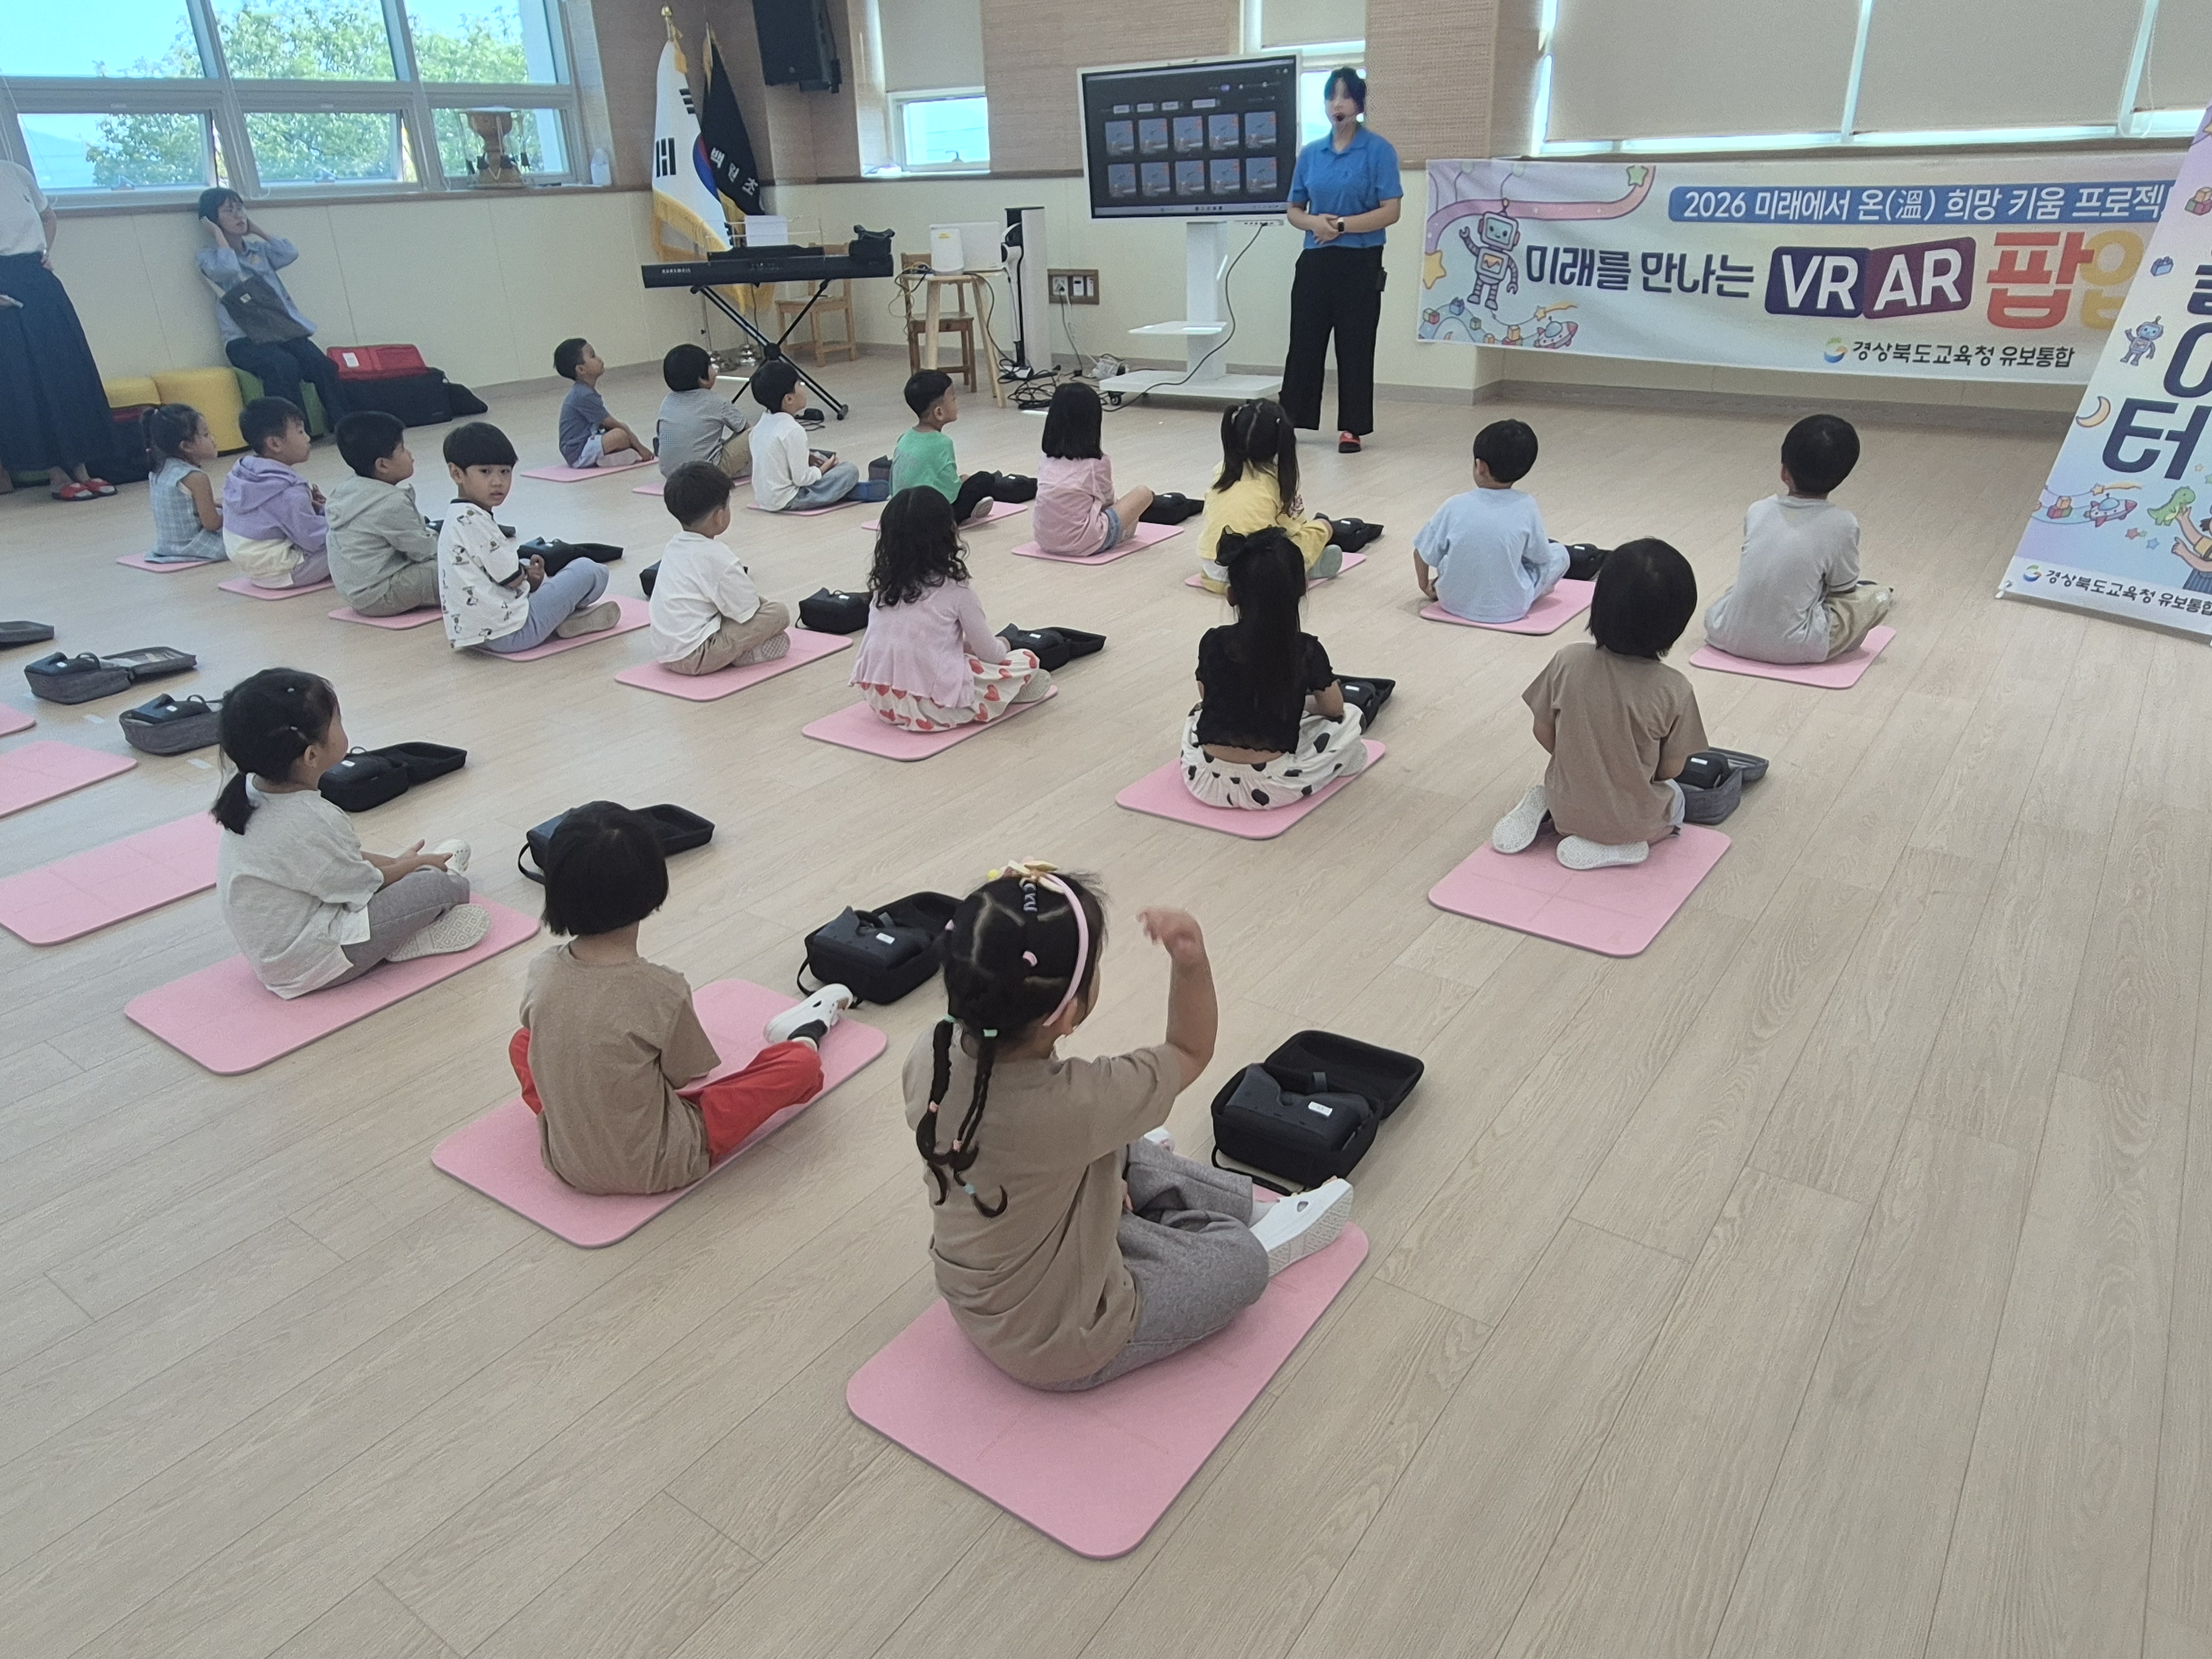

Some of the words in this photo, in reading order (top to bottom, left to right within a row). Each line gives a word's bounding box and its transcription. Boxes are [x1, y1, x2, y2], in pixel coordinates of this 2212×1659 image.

[1683, 191, 1746, 218] 2026
[1755, 189, 1851, 221] 미래에서
[1944, 188, 2002, 221] 희망
[2008, 186, 2067, 220] 키움
[2073, 184, 2169, 220] 프로젝
[1526, 244, 1631, 291] 미래를
[1641, 251, 1755, 299] 만나는
[1781, 252, 1859, 311] VR
[1873, 248, 1963, 311] AR
[1853, 341, 1995, 367] 경상북도교육청
[1999, 346, 2075, 368] 유보통합
[2046, 570, 2156, 604] 경상북도교육청
